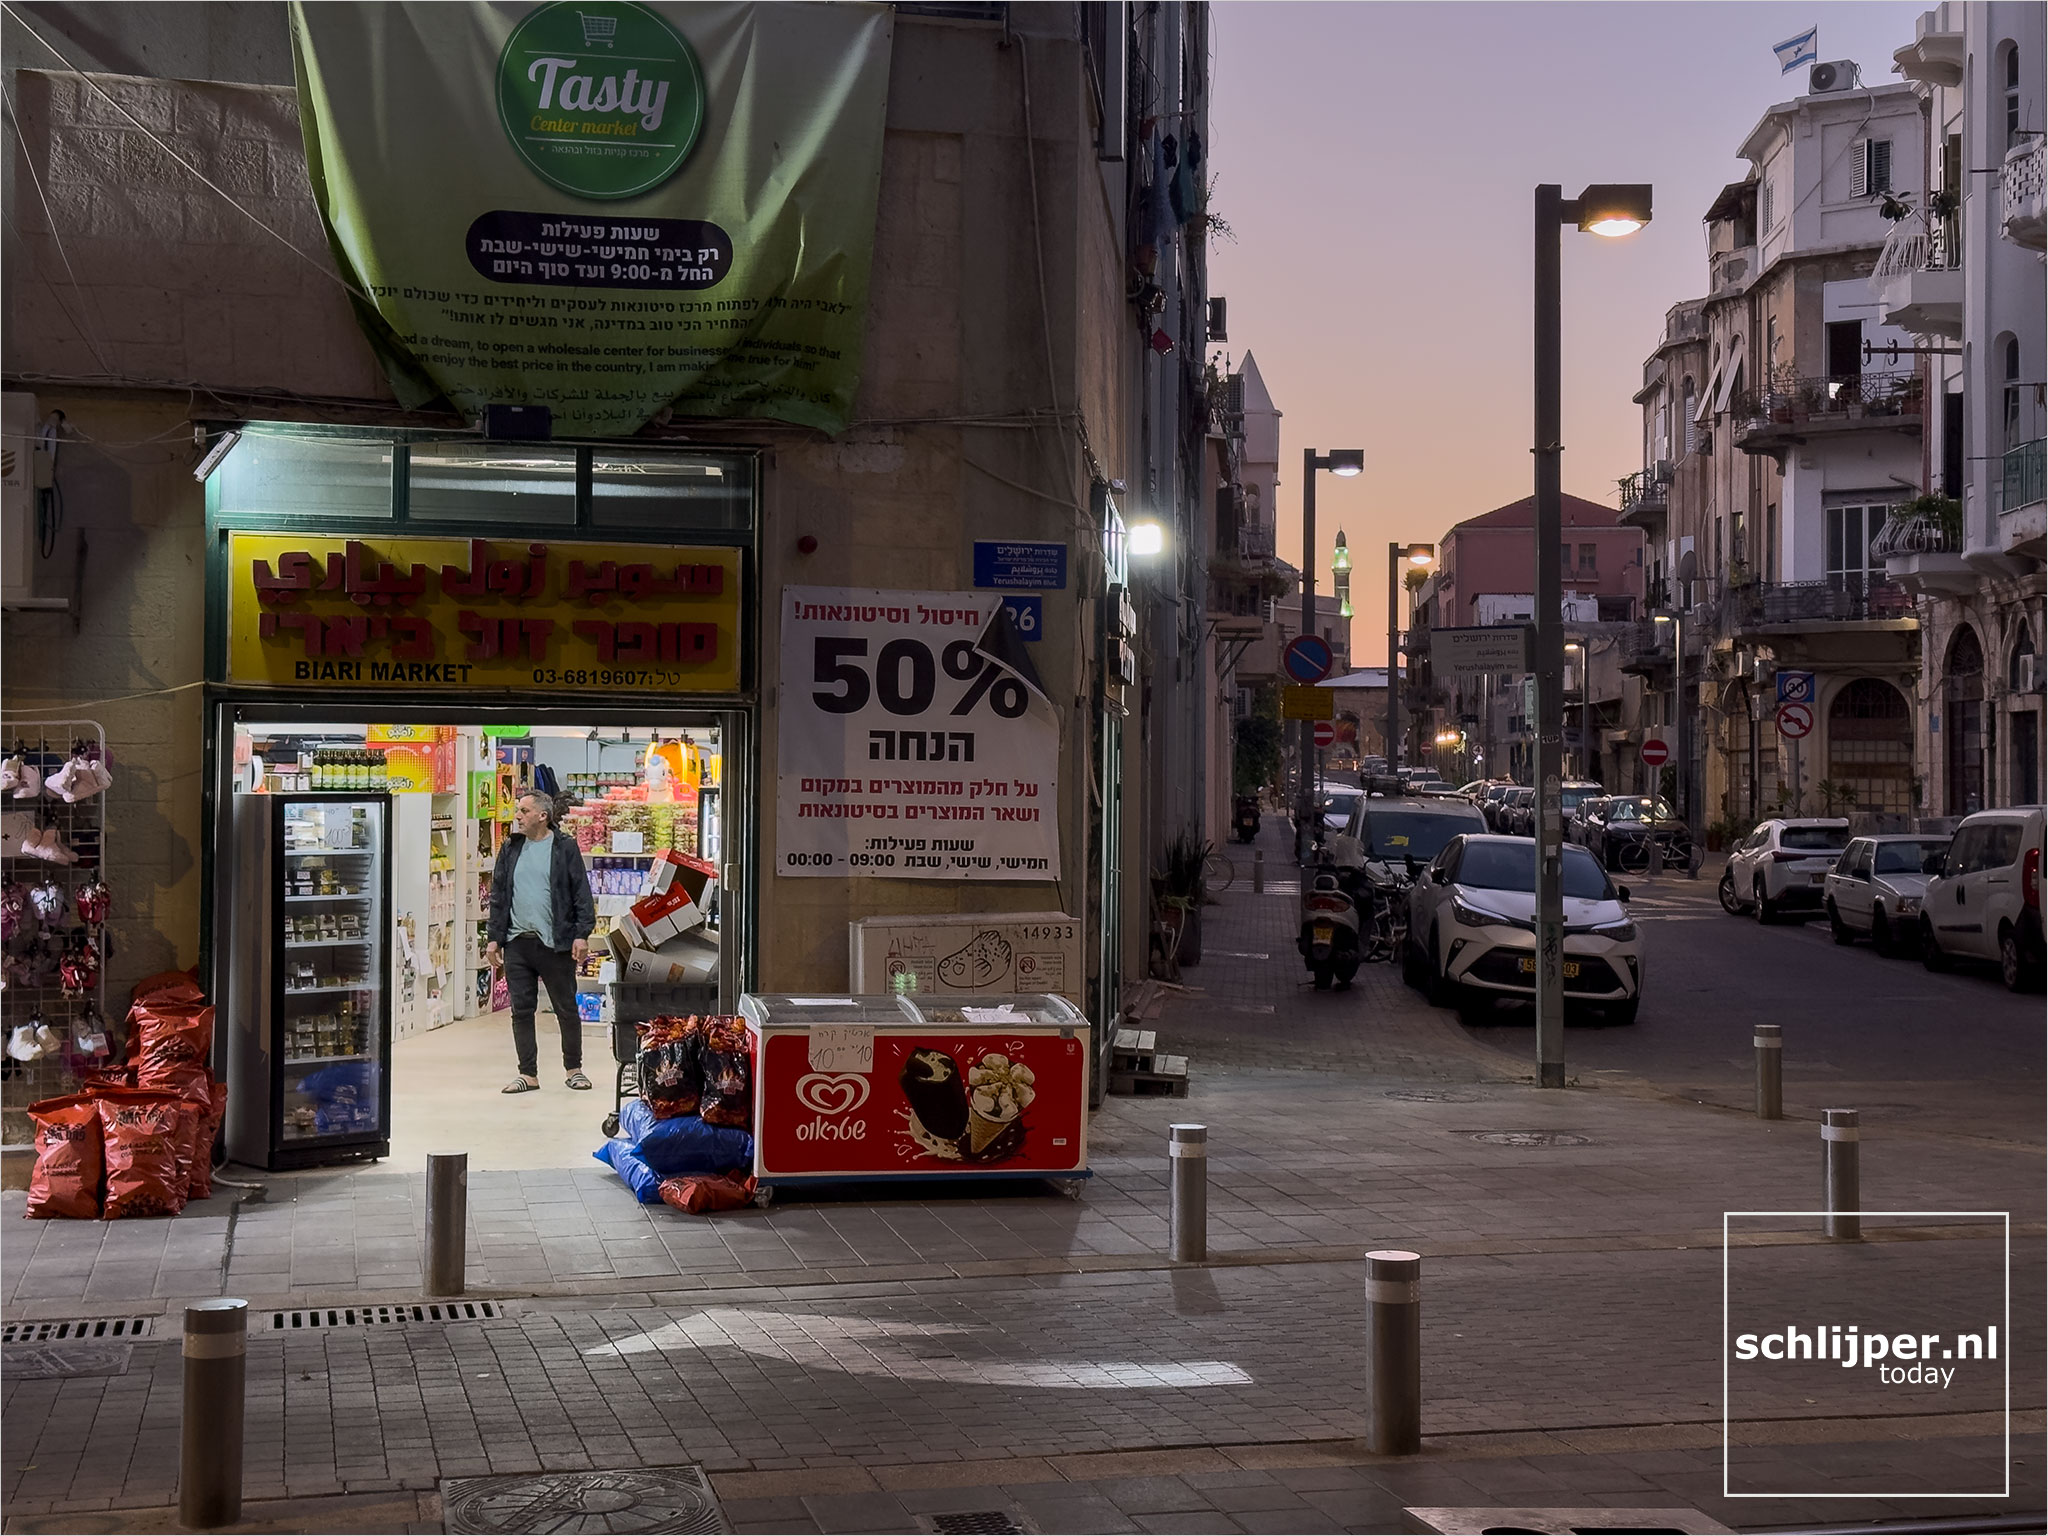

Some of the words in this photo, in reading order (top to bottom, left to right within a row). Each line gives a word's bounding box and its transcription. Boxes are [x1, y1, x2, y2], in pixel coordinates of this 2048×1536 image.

[527, 57, 670, 131] Tasty
[530, 114, 578, 133] Center
[581, 120, 638, 136] market
[552, 145, 582, 155] ובהנאה
[584, 145, 602, 155] בזול
[604, 148, 627, 158] קניות
[628, 149, 649, 158] מרכז
[541, 221, 605, 239] פעילות
[610, 226, 660, 241] שעות
[480, 239, 649, 261] חמישי-שישי-שבת
[654, 246, 693, 262] בימי
[697, 247, 719, 265] רק
[493, 259, 533, 275] היום
[538, 260, 569, 280] סוף
[575, 263, 605, 279] ועד
[611, 264, 673, 281] מ-9:00
[678, 265, 714, 281] החל
[404, 287, 450, 302] שכולם
[455, 294, 478, 305] כדי
[484, 296, 546, 309] וליחידים
[551, 297, 606, 312] לעסקים
[611, 300, 675, 313] סיטונאות
[679, 301, 712, 313] מרכז
[717, 299, 759, 312] לפתוח
[791, 299, 812, 310] היה
[490, 312, 504, 325] לו
[510, 314, 558, 328] מגשים
[563, 318, 585, 329] אני
[650, 319, 673, 331] טוב
[678, 319, 701, 331] הכי
[706, 318, 753, 331] המחיר
[402, 333, 417, 345] ad
[420, 337, 428, 346] a
[431, 335, 473, 353] dream,
[478, 340, 489, 352] to
[493, 342, 523, 355] open
[527, 344, 535, 353] a
[538, 342, 600, 357] wholesale
[603, 346, 643, 357] center
[647, 345, 663, 357] for
[805, 345, 817, 355] so
[817, 345, 841, 361] that
[432, 352, 465, 368] enjoy
[469, 355, 488, 367] the
[492, 357, 519, 370] best
[522, 359, 553, 373] price
[557, 360, 568, 372] in
[572, 360, 592, 372] the
[595, 361, 646, 376] country,
[657, 363, 675, 373] am
[748, 354, 770, 365] true
[773, 355, 790, 366] for
[253, 540, 426, 606] بياري
[441, 539, 549, 600] زول
[560, 558, 724, 605] سوبر
[993, 577, 1042, 587] Yerushalayim
[794, 601, 910, 624] וסיטונאות!
[917, 605, 979, 626] חיסול
[260, 611, 435, 660] ביארי
[459, 610, 554, 662] זול
[571, 619, 718, 663] סופר
[1453, 634, 1491, 643] ירושלים
[295, 661, 362, 681] BIARI
[370, 662, 472, 683] MARKET
[1453, 663, 1504, 672] Yerushalayim
[812, 636, 1028, 719] 50%
[869, 730, 975, 762] הנחה
[1542, 735, 1559, 743] 1UP
[801, 777, 862, 794] במקום
[869, 778, 963, 796] מהמוצרים
[969, 780, 1008, 799] חלק
[1014, 778, 1038, 797] על
[798, 803, 898, 819] בסיטונאות
[905, 805, 984, 821] המוצרים
[991, 807, 1040, 822] ושאר
[865, 836, 925, 851] פעילות:
[931, 839, 974, 852] שעות
[787, 853, 833, 867] 00:00
[849, 853, 895, 867] 09:00
[904, 854, 941, 868] שבת
[946, 855, 991, 870] שישי,
[996, 857, 1048, 872] חמישי,
[1022, 926, 1073, 940] 14933
[631, 961, 644, 973] 12
[795, 1115, 866, 1141] שטראוס
